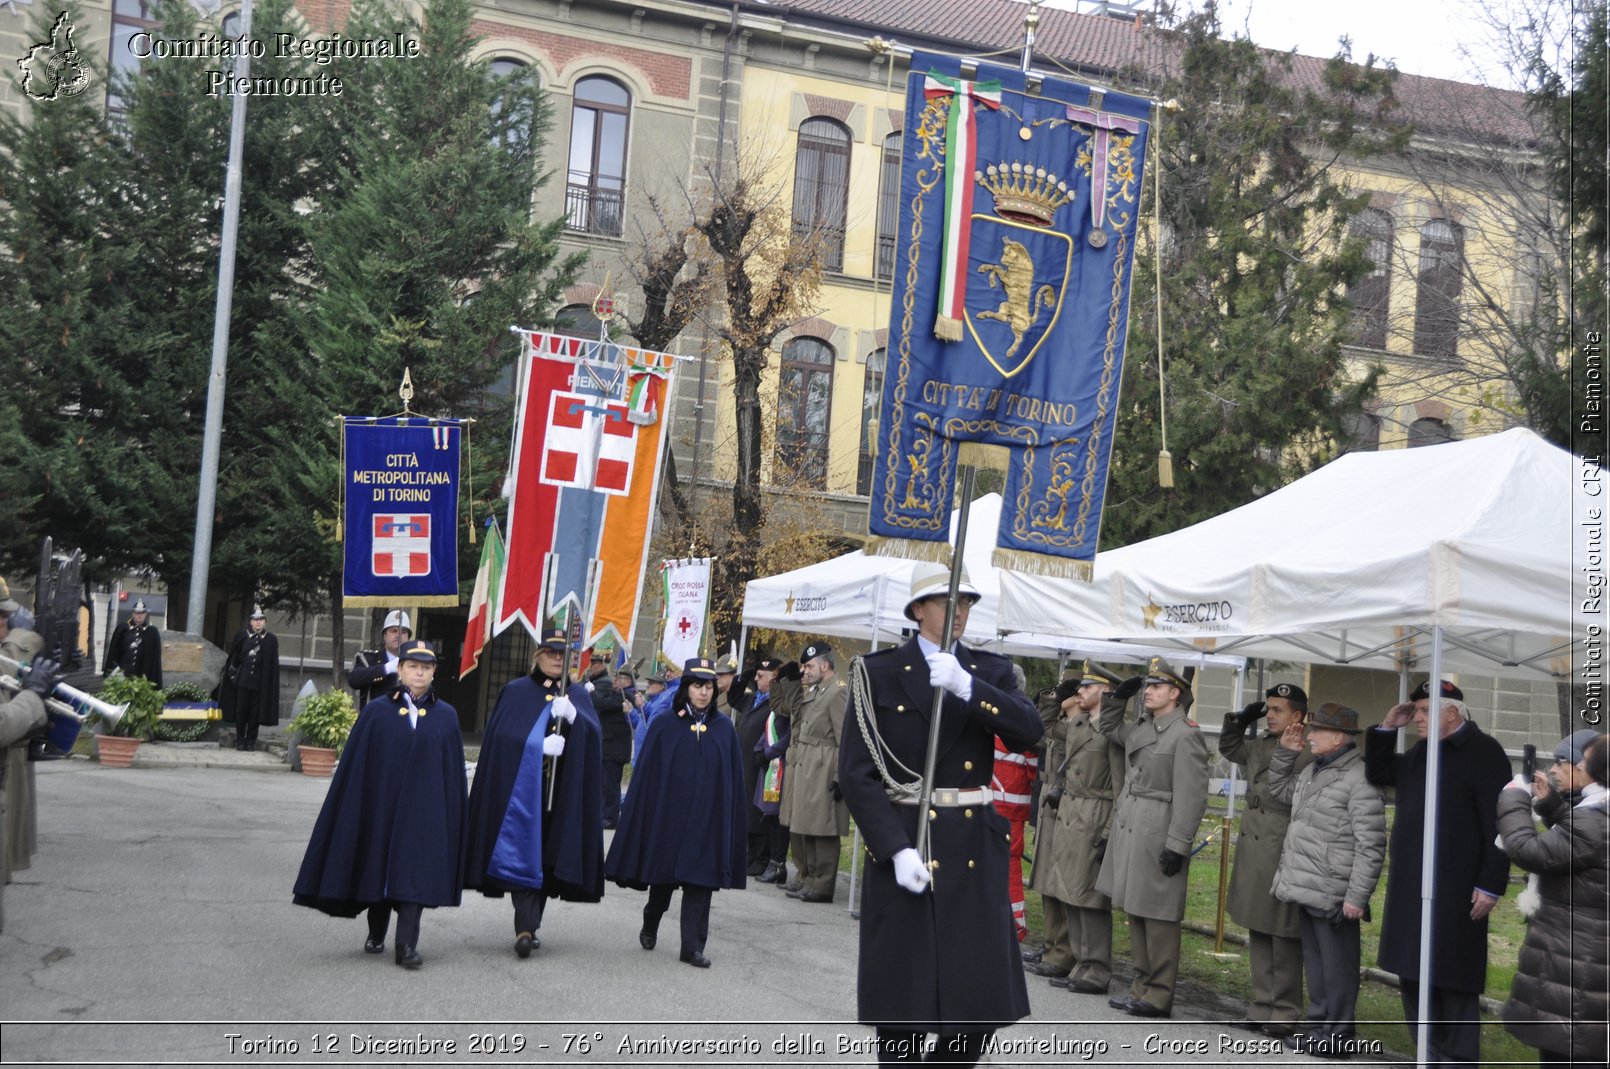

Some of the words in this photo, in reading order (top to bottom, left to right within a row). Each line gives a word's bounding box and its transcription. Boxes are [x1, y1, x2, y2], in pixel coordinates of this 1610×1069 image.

[923, 379, 985, 411] CITTA'
[1006, 394, 1076, 426] TORINO
[386, 452, 419, 468] CITTÀ
[353, 470, 451, 485] METROPOLITANA
[373, 488, 385, 502] DI
[388, 488, 431, 502] TORINO
[687, 581, 704, 589] ROSSA
[795, 597, 827, 611] ESERCITO
[1164, 600, 1232, 623] ESERCITO
